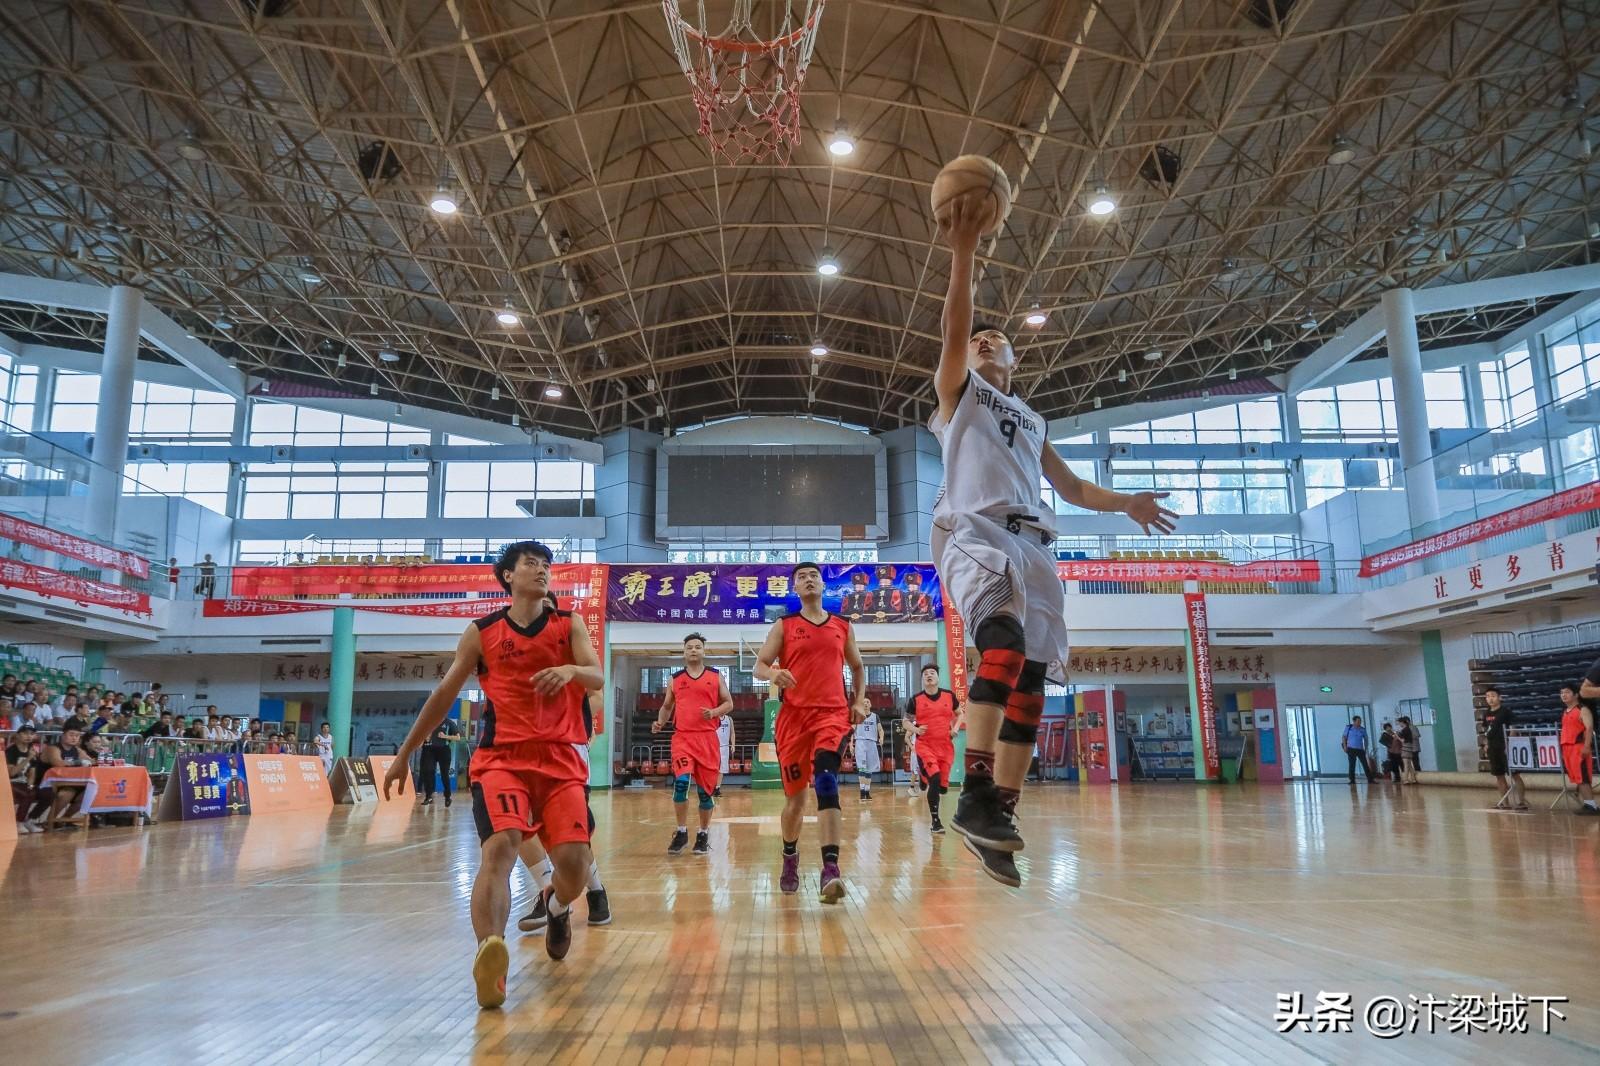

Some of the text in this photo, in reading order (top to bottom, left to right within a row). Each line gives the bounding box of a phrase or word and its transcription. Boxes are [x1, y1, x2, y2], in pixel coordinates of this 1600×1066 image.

[1000, 419, 1017, 448] 9
[1434, 539, 1600, 599] 让更多青
[657, 608, 708, 619] 中国高度
[950, 614, 964, 660] 百年匠心
[675, 756, 689, 769] 15
[1512, 745, 1557, 766] 00 00
[783, 763, 802, 783] 16
[496, 793, 520, 816] 11
